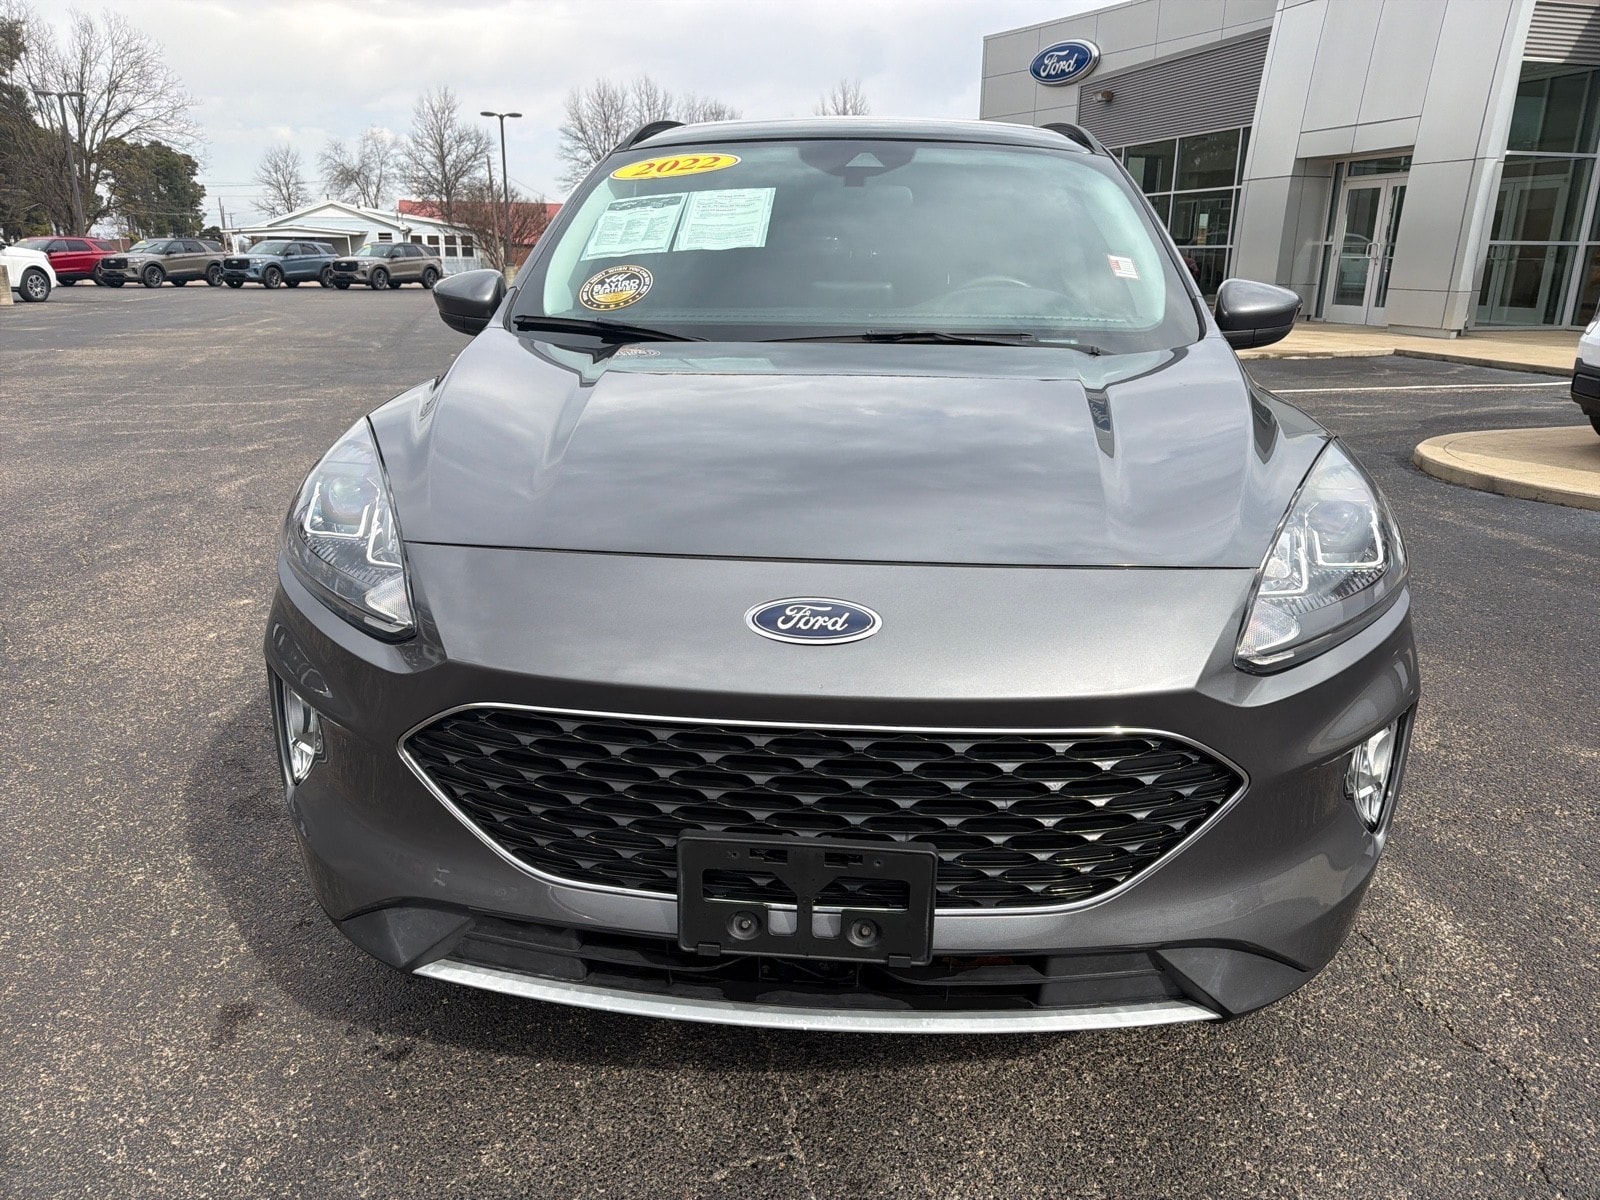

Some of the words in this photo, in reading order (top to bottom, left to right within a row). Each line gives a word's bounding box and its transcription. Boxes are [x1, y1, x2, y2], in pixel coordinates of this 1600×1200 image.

[1040, 50, 1078, 77] Ford
[631, 157, 720, 176] 2022
[592, 284, 638, 296] CERTIFIED
[593, 279, 640, 291] BAYIRD
[777, 604, 850, 631] Ford
